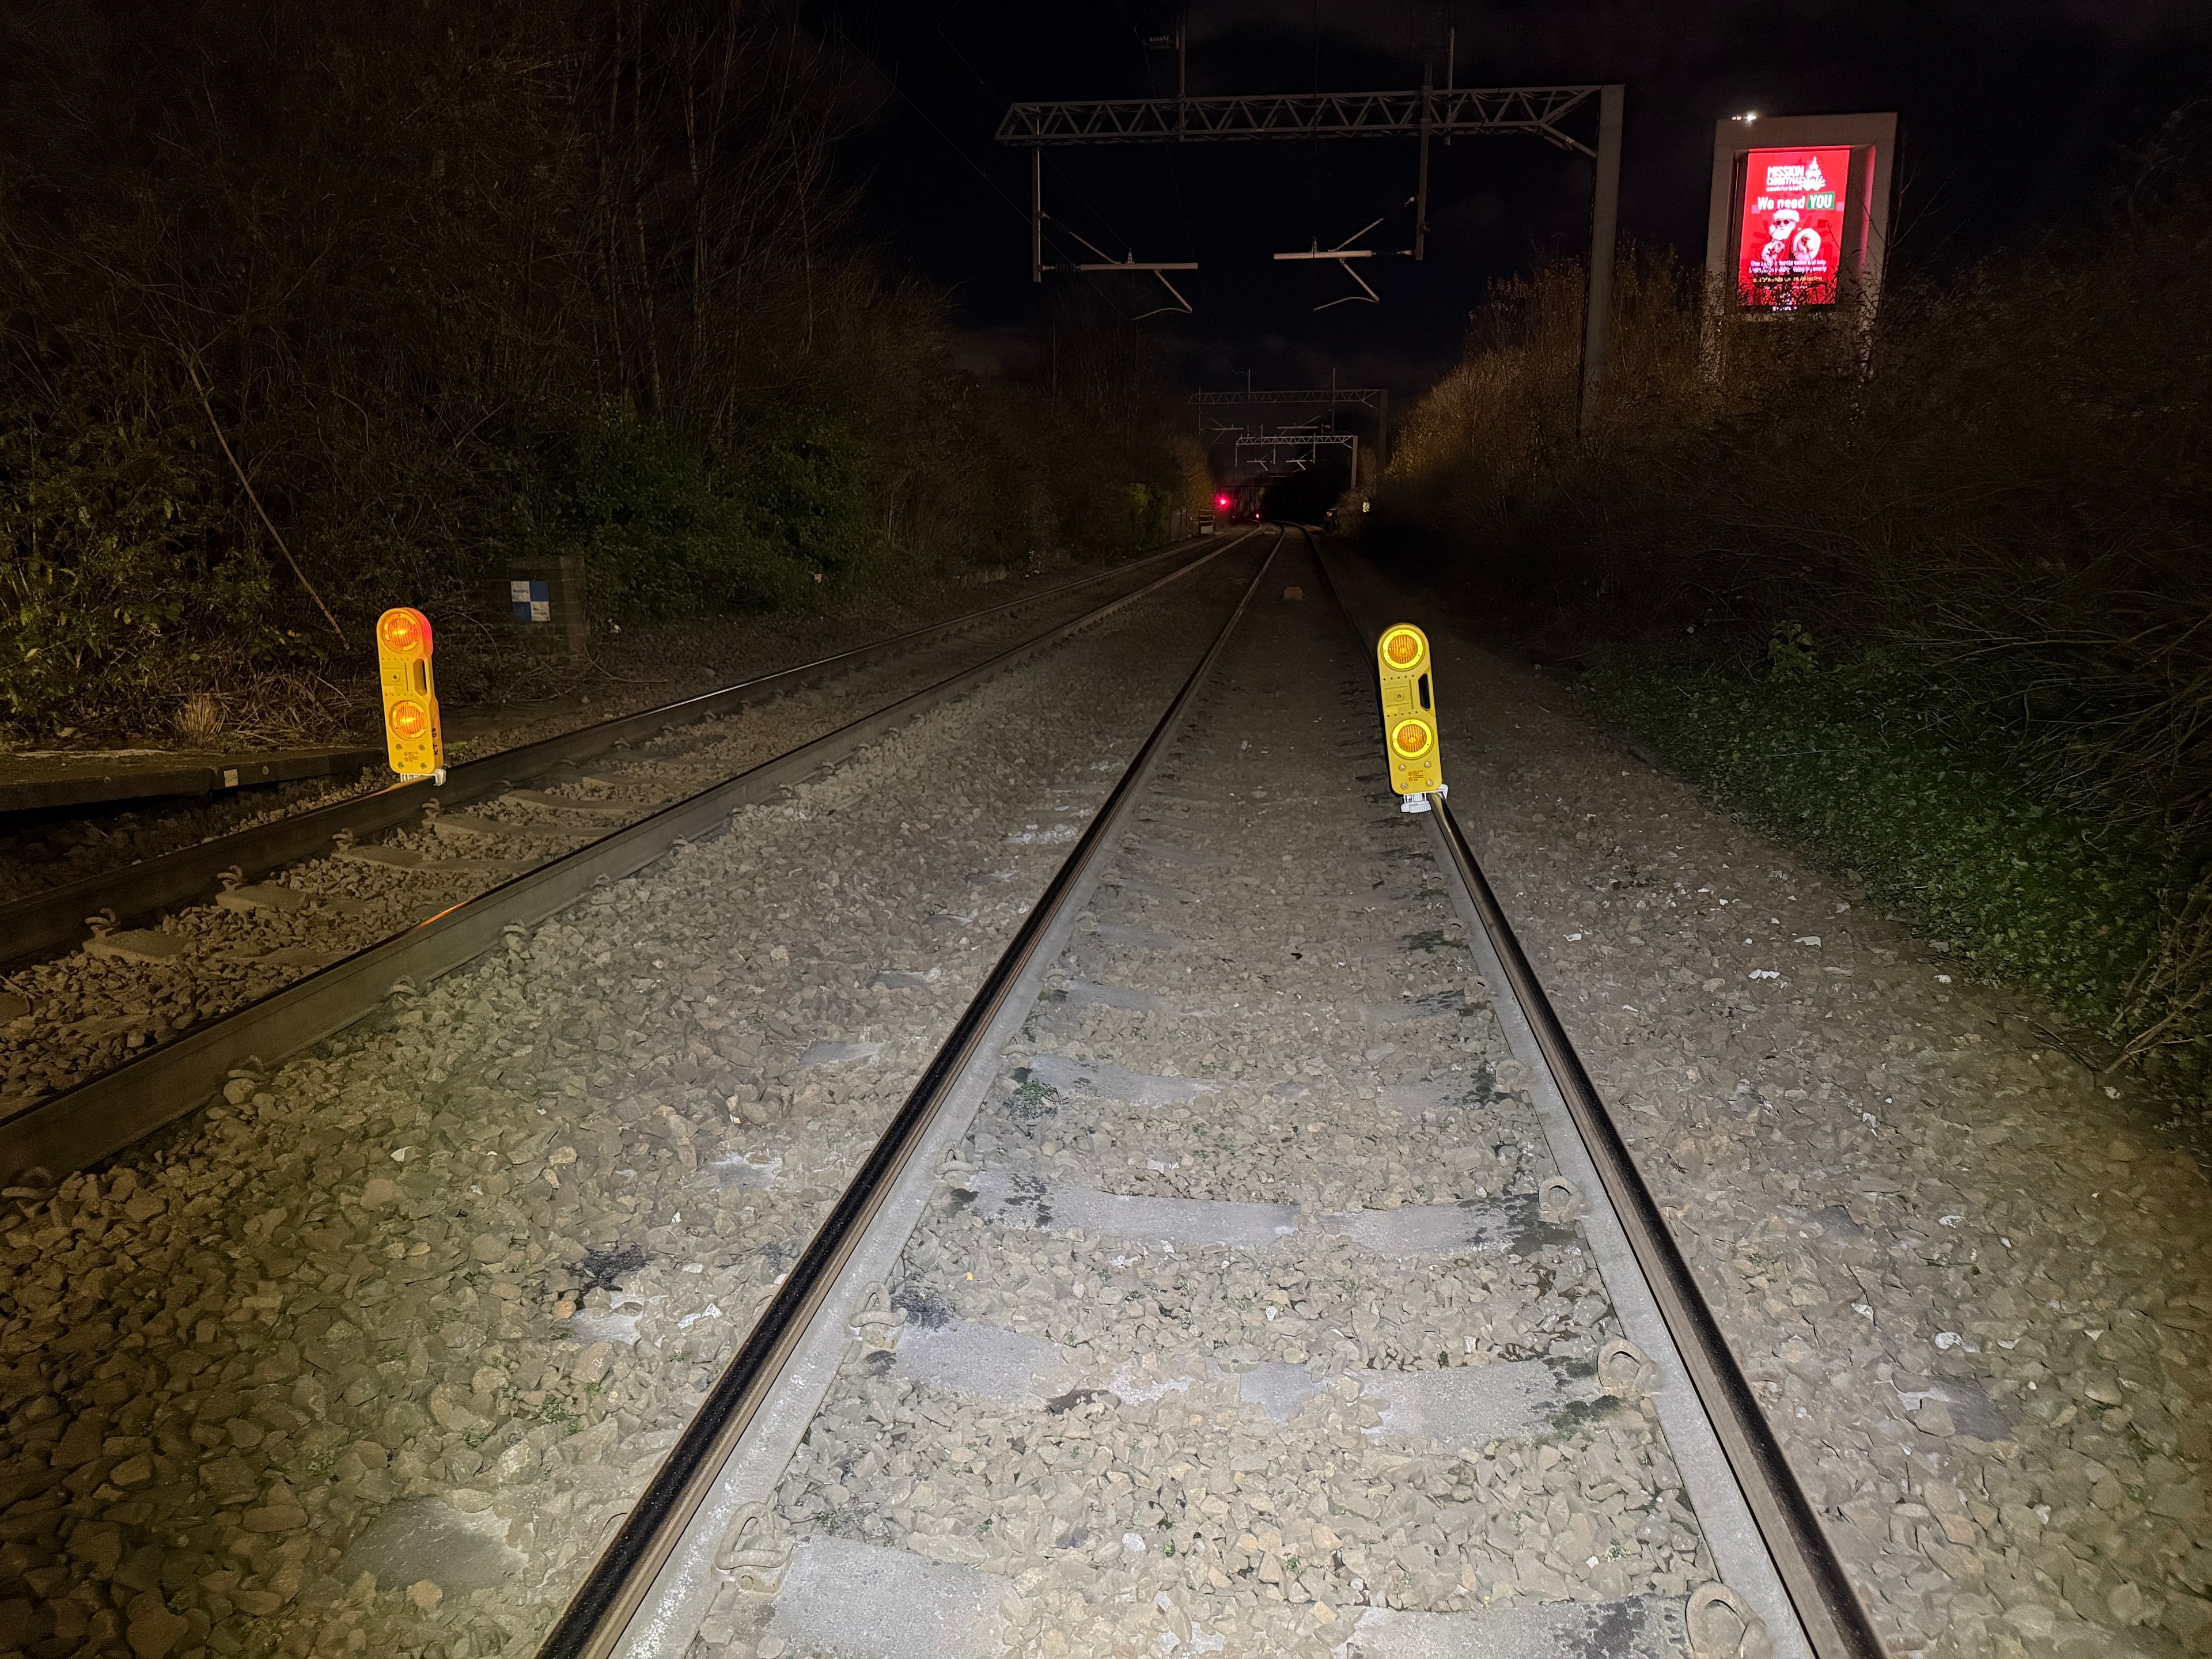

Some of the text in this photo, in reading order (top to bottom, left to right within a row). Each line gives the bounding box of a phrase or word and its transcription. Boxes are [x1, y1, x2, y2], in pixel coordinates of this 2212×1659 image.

[1758, 194, 1832, 210] We need YOU
